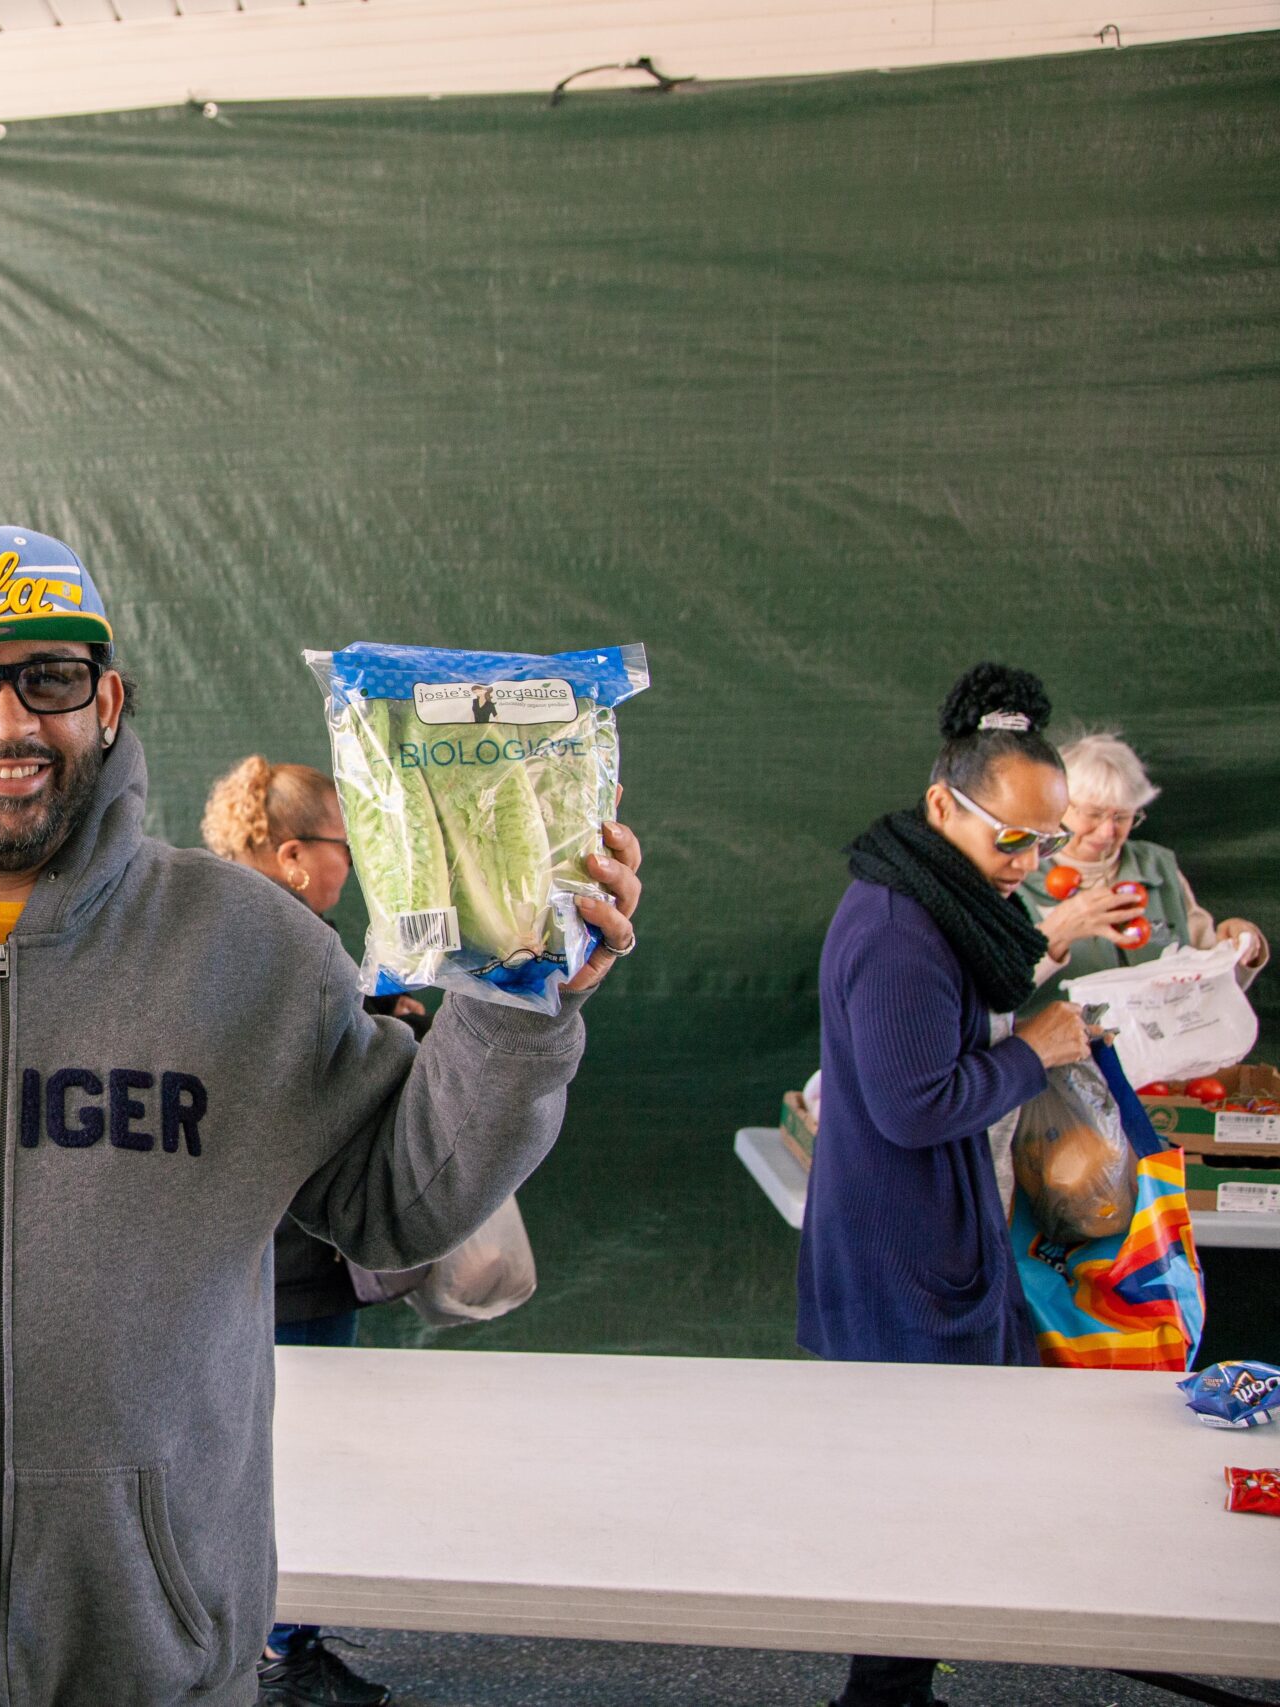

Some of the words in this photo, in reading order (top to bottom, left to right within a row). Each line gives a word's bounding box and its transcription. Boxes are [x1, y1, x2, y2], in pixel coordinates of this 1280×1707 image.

[419, 687, 471, 703] josie's
[495, 685, 568, 702] organics
[398, 736, 587, 769] BIOLOGIQUE
